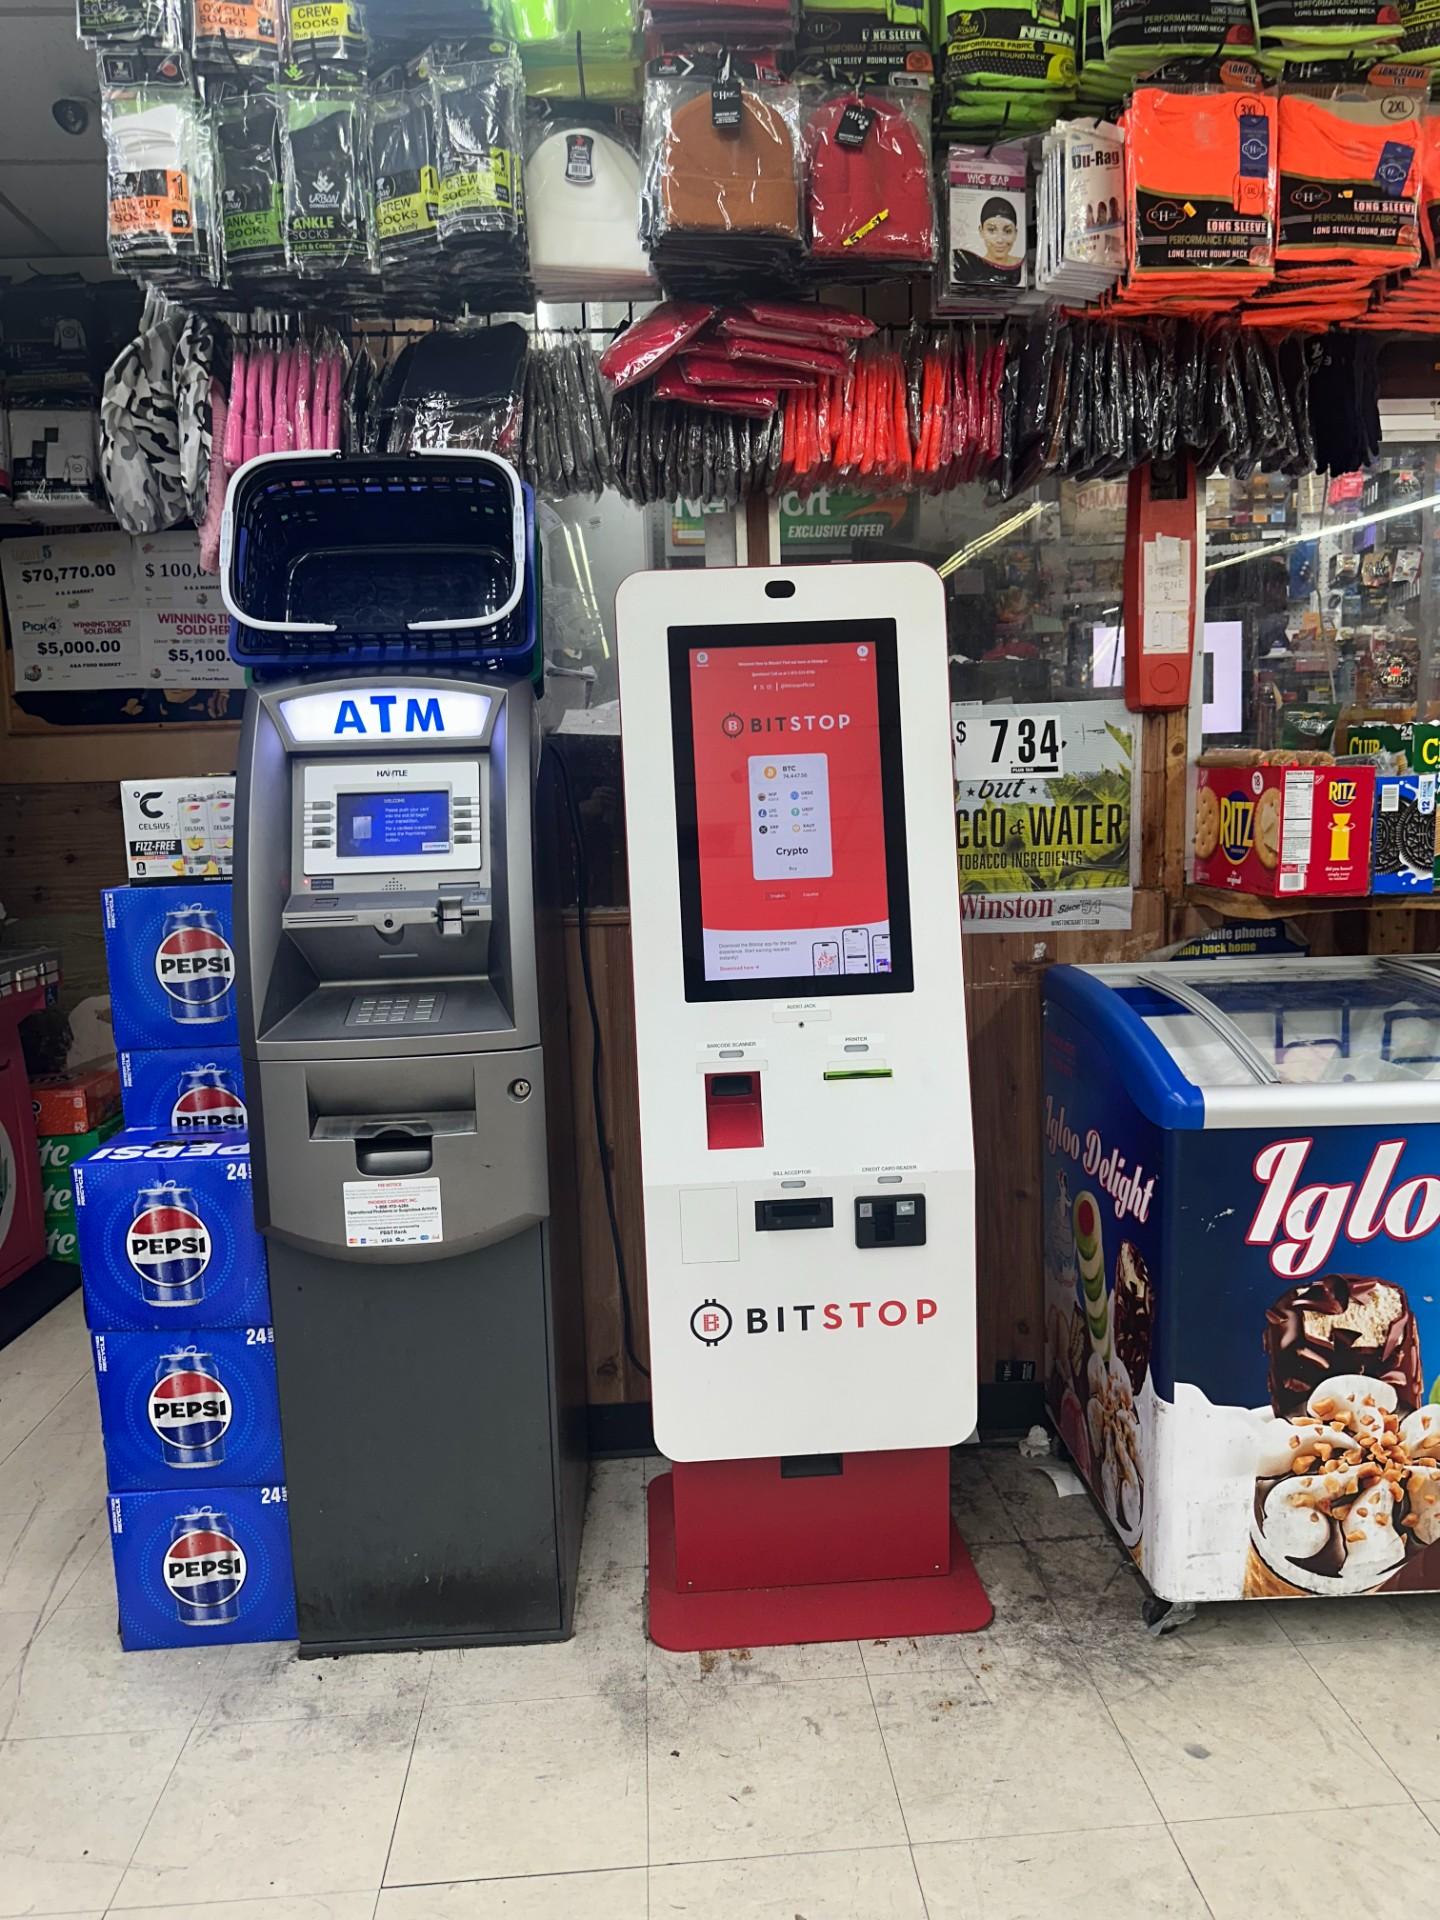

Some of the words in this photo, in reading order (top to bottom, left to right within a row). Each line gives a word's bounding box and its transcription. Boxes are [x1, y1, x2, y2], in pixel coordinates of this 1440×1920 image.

[297, 6, 332, 20] CREW
[1144, 14, 1200, 24] PERFORMANCE
[1201, 14, 1226, 24] FABRIC
[293, 17, 340, 30] SOCKS
[1144, 25, 1161, 34] LONG
[1162, 25, 1186, 33] SLEEVE
[1187, 24, 1208, 33] ROUND
[862, 29, 889, 41] LNG
[889, 29, 922, 40] SLEEVE
[1019, 25, 1075, 47] NEON
[826, 43, 876, 54] PERFORMAE
[951, 40, 1005, 52] PERFORMANCE
[1006, 41, 1033, 50] FABRIC
[866, 56, 887, 65] ROUND
[887, 56, 905, 66] NECK
[952, 52, 973, 62] LONG
[973, 49, 999, 58] SLEEVE
[1000, 51, 1026, 60] ROUND
[1027, 52, 1045, 61] NECK
[1228, 63, 1250, 75] LONG
[1377, 66, 1398, 77] LONG
[1398, 67, 1425, 78] SLEEVE
[1240, 103, 1257, 116] 3XL
[1387, 99, 1409, 114] 2XL
[496, 151, 505, 171] 1
[1071, 151, 1120, 170] Du-Rag
[172, 174, 184, 196] 1
[423, 168, 435, 190] 1
[445, 173, 479, 190] CREW
[967, 174, 986, 185] WIG
[989, 175, 1010, 186] CAP
[139, 199, 161, 210] CUT
[308, 191, 341, 204] URBAN
[379, 197, 413, 214] CREW
[1353, 200, 1380, 214] LONG
[1382, 201, 1417, 215] SLEEVE
[226, 212, 270, 228] ANKLET
[292, 215, 335, 230] ANKLE
[378, 209, 419, 228] SOCKS
[1206, 220, 1232, 233] LONG
[1233, 219, 1268, 233] SLEEVE
[1313, 213, 1367, 224] PERFORMANCE
[1368, 213, 1398, 225] FABRIC
[227, 225, 270, 240] SOCKS
[292, 228, 330, 240] SOCKS
[1312, 225, 1327, 235] LONG
[1328, 225, 1355, 235] SLEEVE
[1356, 226, 1378, 236] ROUND
[1378, 227, 1397, 237] NECK
[1168, 234, 1222, 247] PERFORMANCE
[1223, 234, 1249, 246] FABRIC
[1167, 249, 1183, 259] LONG
[1183, 249, 1208, 259] SLEEVE
[1209, 249, 1232, 259] ROUND
[1232, 249, 1248, 259] NECK
[779, 486, 831, 517] ort
[787, 524, 848, 539] EXCLUSIVE
[848, 523, 885, 537] OFFER
[21, 563, 117, 584] $70,770.00
[144, 562, 156, 579] $
[47, 621, 58, 631] 4
[73, 620, 105, 630] WINNING
[105, 619, 132, 629] TICKET
[157, 613, 218, 625] WINNING
[83, 627, 104, 636] SOLD
[104, 626, 123, 635] HERE
[176, 624, 207, 636] SOLD
[208, 624, 231, 636] HER
[37, 640, 121, 657] $5,000.00
[168, 648, 231, 665] $5,100.
[333, 695, 446, 734] ATM
[750, 713, 851, 733] BITSTOP
[1401, 725, 1414, 737] 24
[955, 720, 967, 746] $
[989, 718, 1059, 764] 7.34
[782, 765, 796, 773] BTC
[978, 778, 1026, 799] but
[1328, 781, 1358, 802] RITZ
[1421, 799, 1431, 812] 12
[138, 822, 171, 831] CELSIUS
[183, 825, 206, 833] CELSIUS
[957, 807, 1006, 849] CCO
[1009, 818, 1026, 837] &
[1029, 803, 1123, 847] WATER
[1219, 796, 1255, 848] RITZ
[135, 840, 177, 852] FIZZ-FREE
[776, 846, 809, 857] Crypto
[959, 852, 1008, 871] TOBACCO
[1011, 850, 1083, 869] INGREDIENTS
[960, 893, 1053, 921] Winston
[1057, 904, 1081, 914] Since
[1200, 928, 1233, 941] obile
[1234, 927, 1277, 941] phones
[1202, 943, 1228, 954] back
[1228, 942, 1257, 953] home
[160, 956, 231, 975] PEPSI
[176, 1113, 244, 1128] PEPSI
[87, 1141, 250, 1161] PEPSI
[1045, 1095, 1081, 1160] Igloo
[1081, 1128, 1156, 1225] Delight
[226, 1162, 248, 1181] 24
[132, 1236, 206, 1256] PEPSI
[746, 1298, 938, 1335] BITSTOP
[246, 1327, 267, 1346] 24
[100, 1335, 108, 1372] RECYCLE
[153, 1399, 227, 1419] PEPSI
[260, 1486, 281, 1505] 24
[115, 1497, 123, 1534] RECYCLE
[168, 1556, 242, 1580] PEPSI
